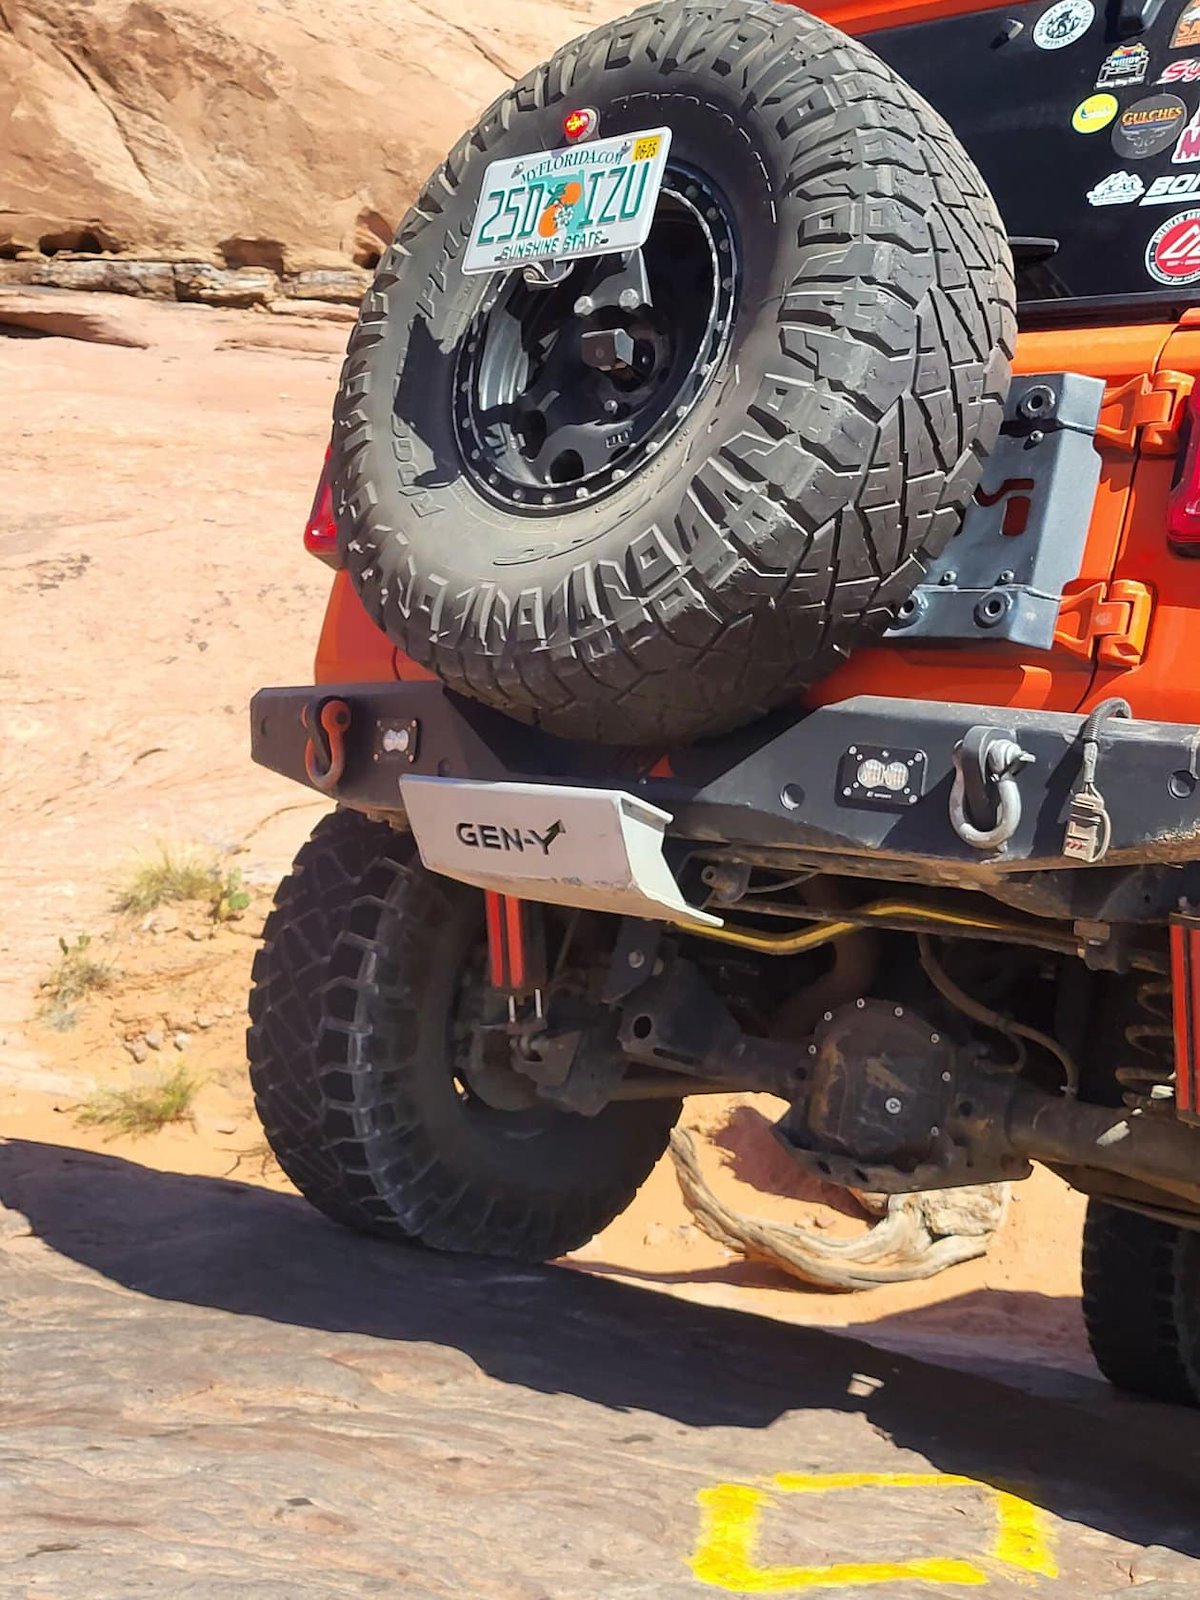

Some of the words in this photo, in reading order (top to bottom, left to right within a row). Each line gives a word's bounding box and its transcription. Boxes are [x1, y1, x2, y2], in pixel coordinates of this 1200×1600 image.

[1122, 107, 1183, 126] GULCHES
[520, 149, 625, 183] MYFLORIDA.COM
[477, 181, 545, 246] 25D
[501, 237, 559, 261] SUNSHINE
[563, 230, 603, 251] STATE
[456, 819, 566, 855] GEN-Y
